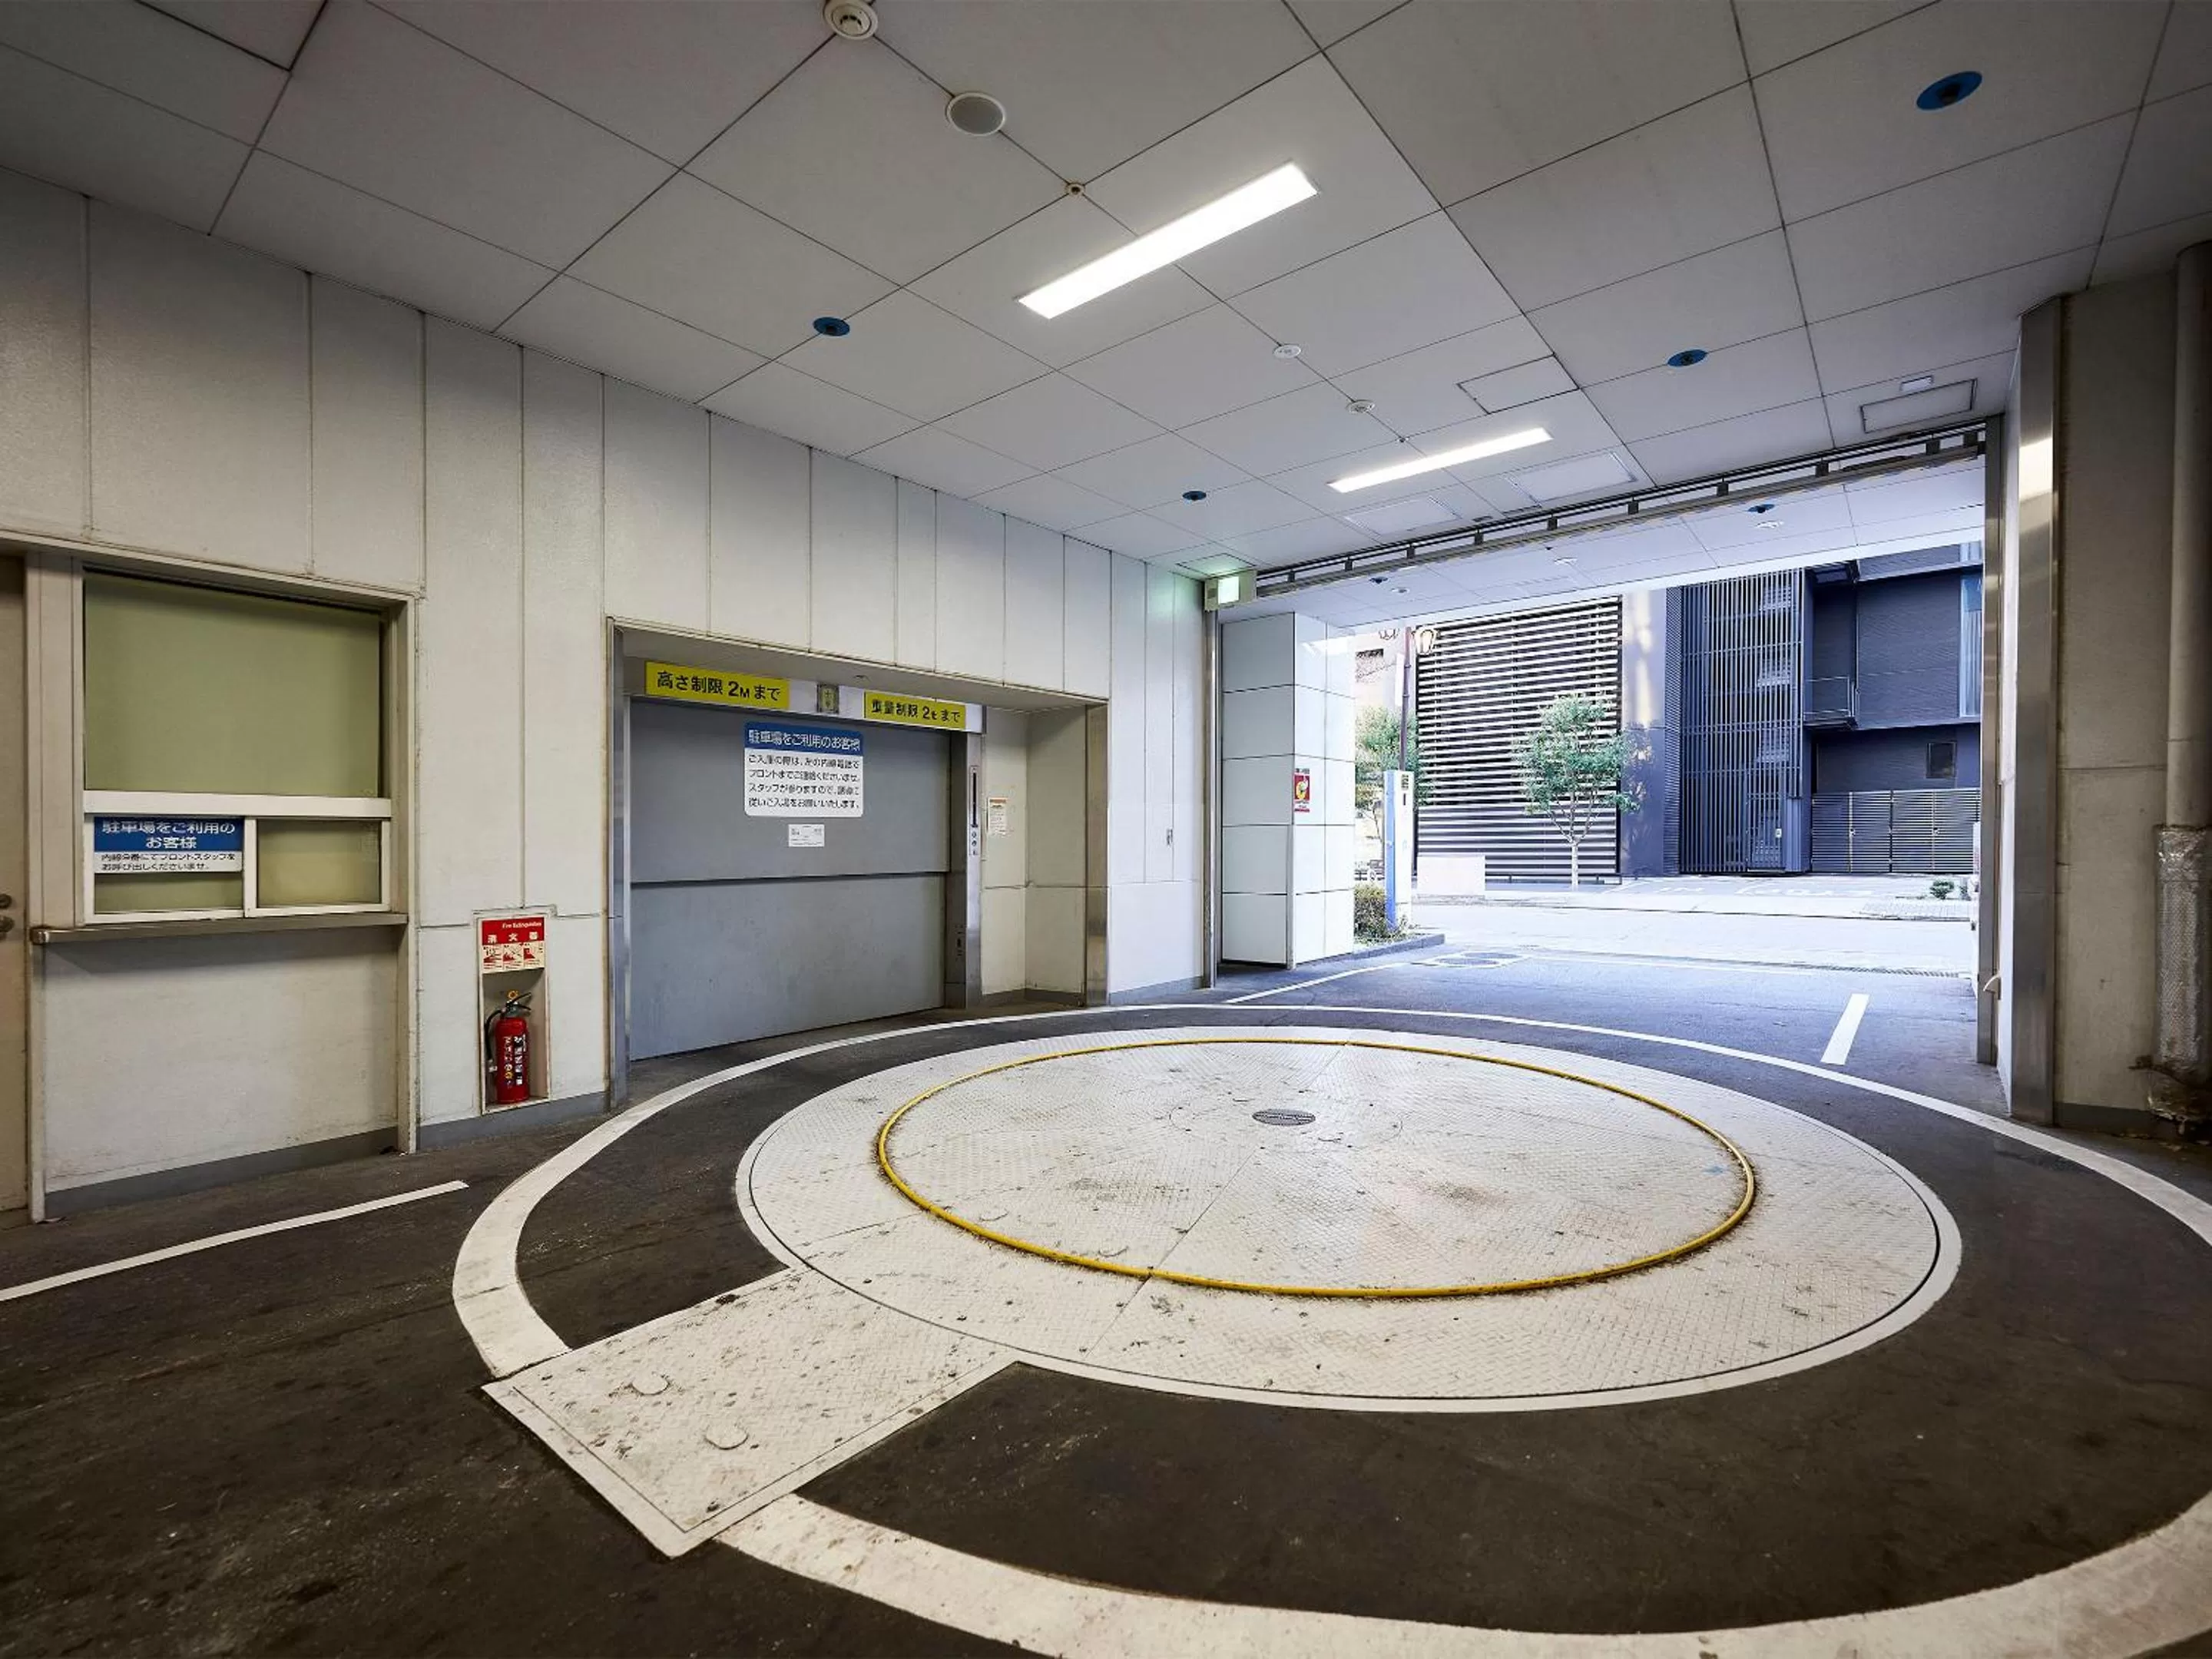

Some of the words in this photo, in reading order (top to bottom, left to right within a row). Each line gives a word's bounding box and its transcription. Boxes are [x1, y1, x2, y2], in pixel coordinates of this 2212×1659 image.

[748, 729, 860, 751] 駐車場をご利用のお客様
[101, 820, 236, 835] 駐車場をご利用の
[146, 836, 197, 849] お客様
